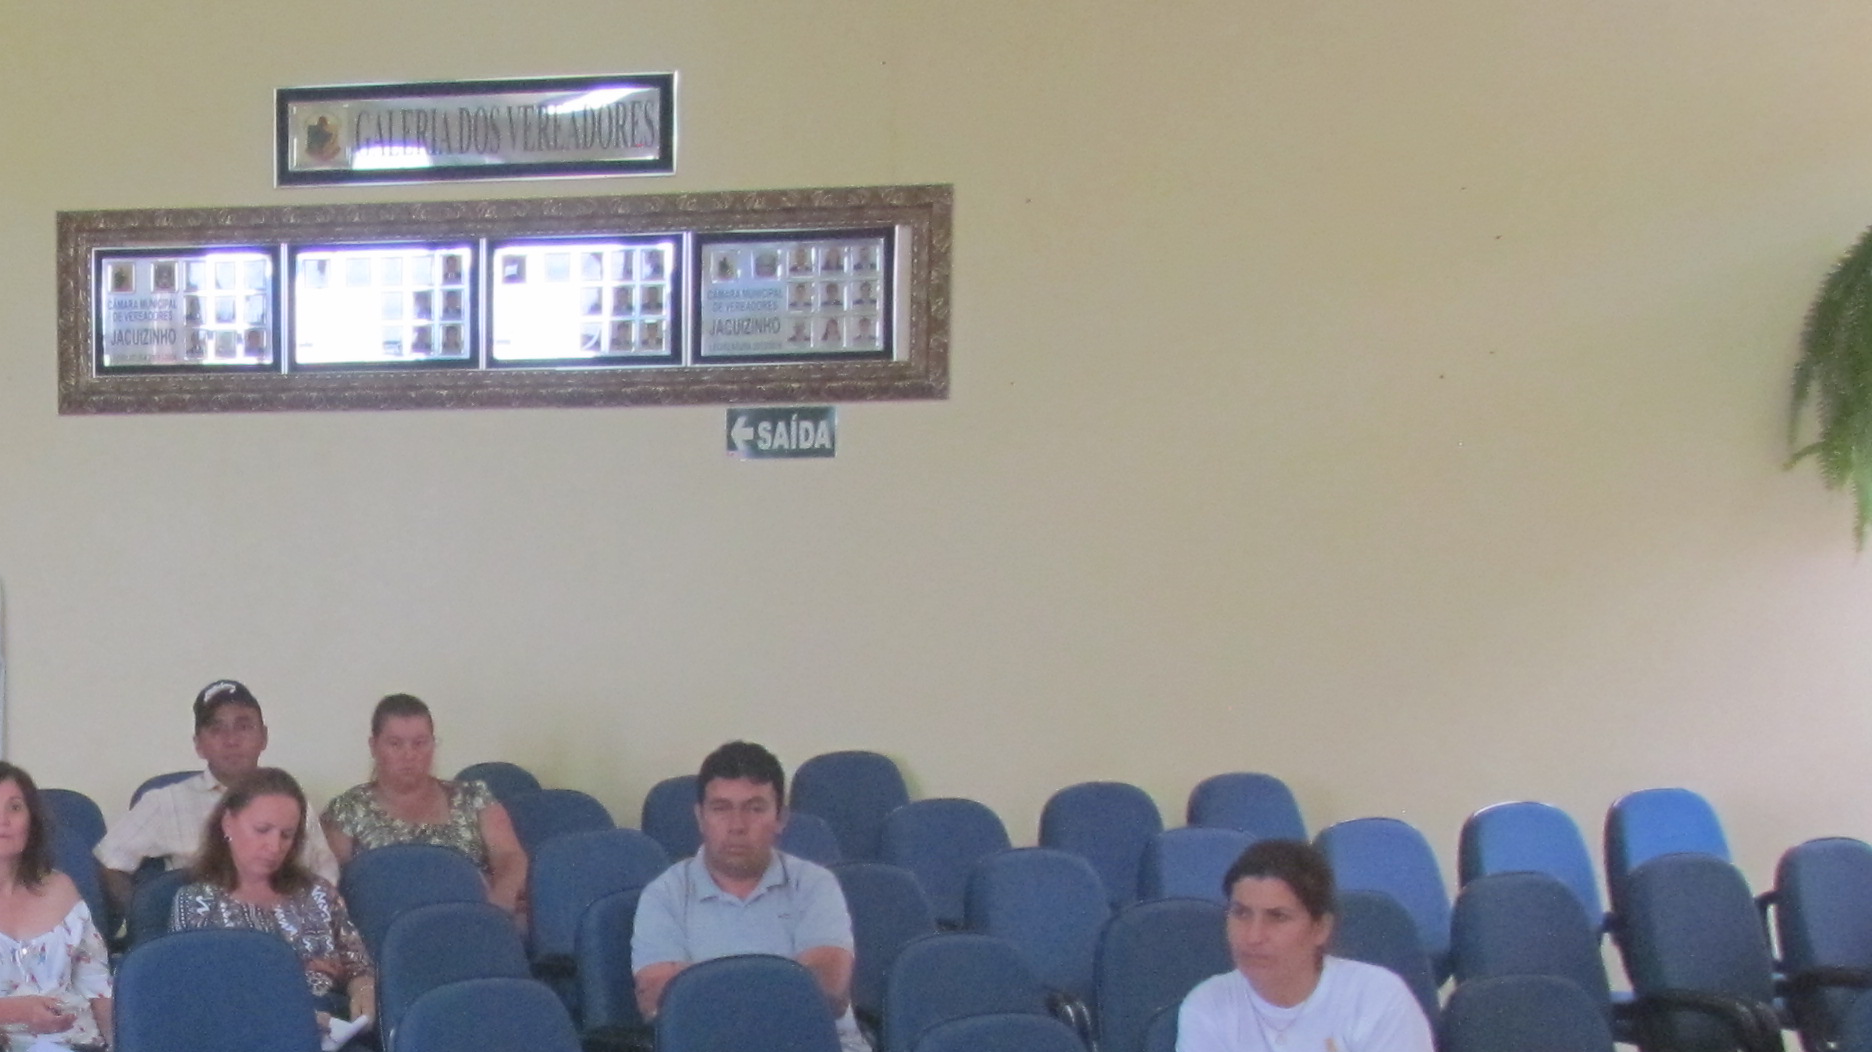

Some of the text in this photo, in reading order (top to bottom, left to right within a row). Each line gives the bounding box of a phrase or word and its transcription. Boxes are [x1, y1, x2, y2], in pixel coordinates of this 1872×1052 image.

[355, 100, 655, 156] GALERIA DOS VEREADORES
[111, 327, 177, 346] JACUIZINHO
[709, 316, 781, 337] JACUIZINHO
[757, 413, 832, 450] SAÍDA
